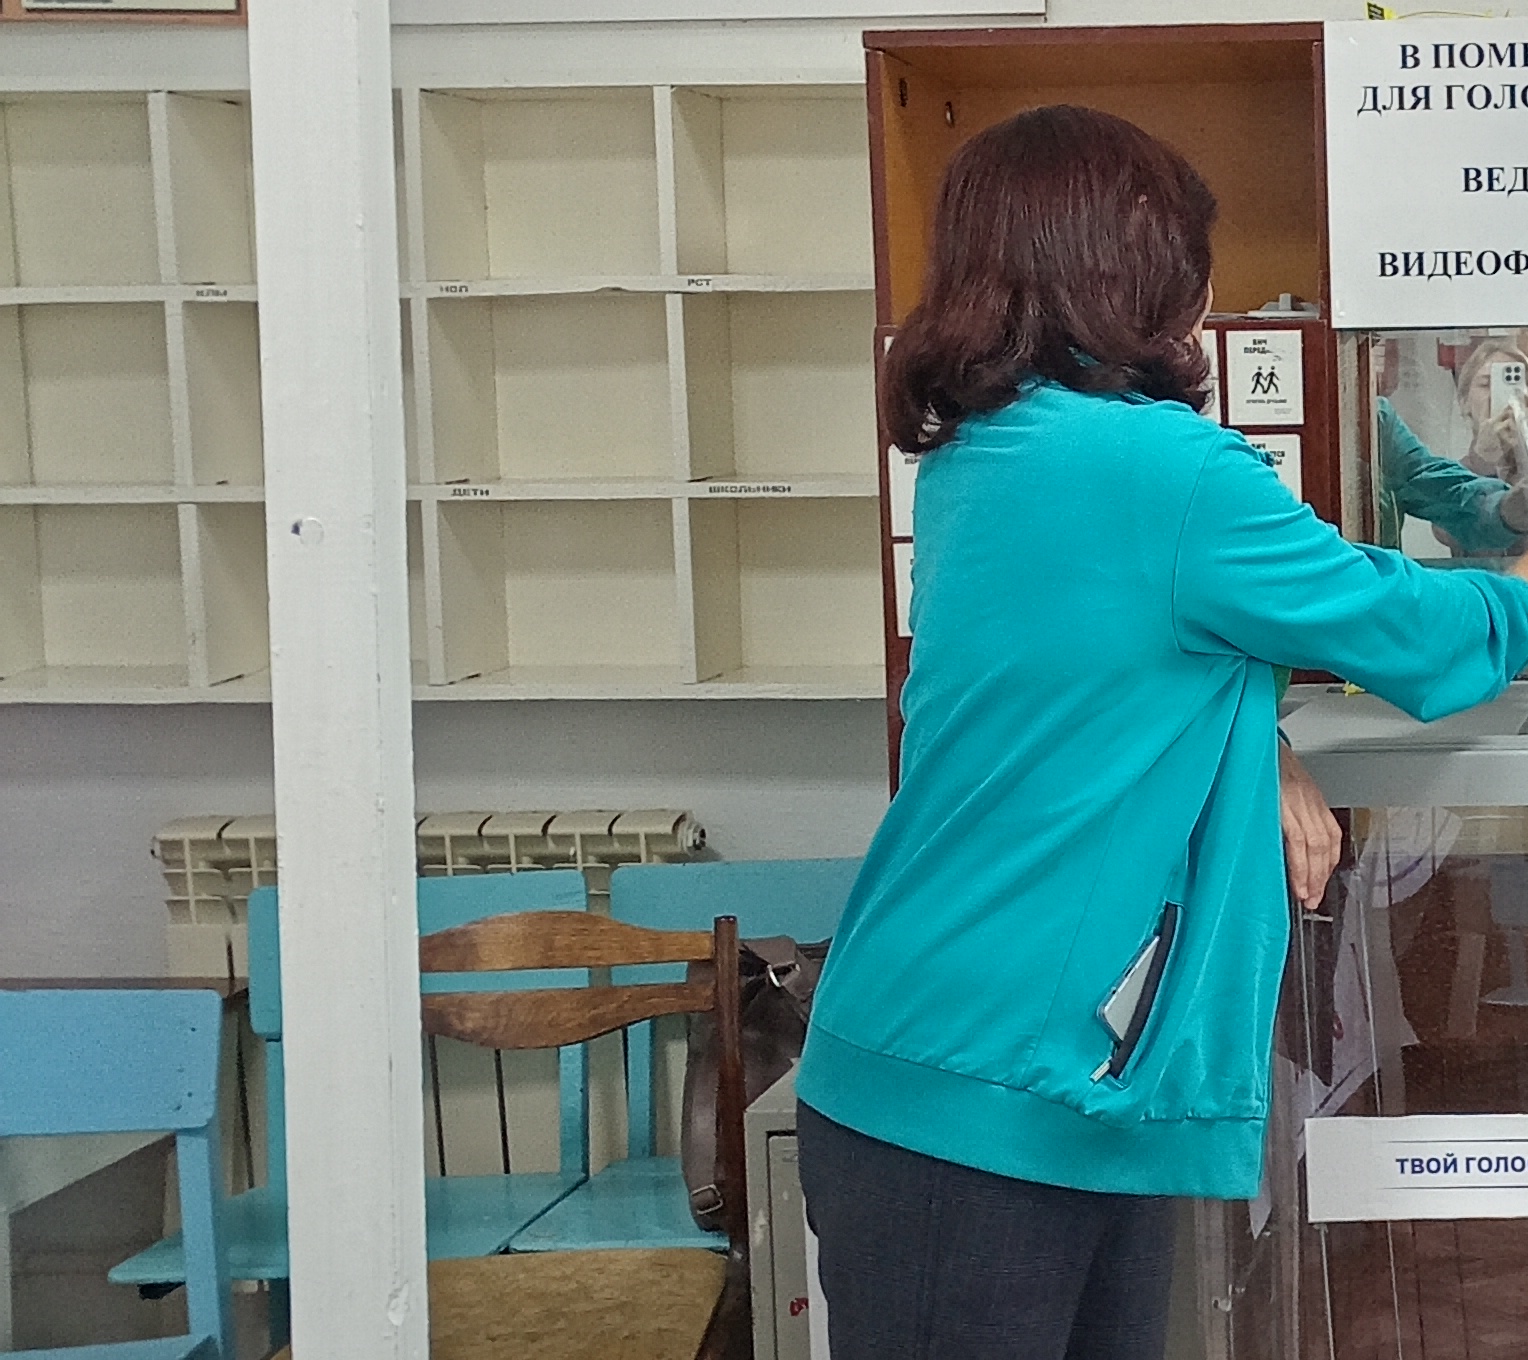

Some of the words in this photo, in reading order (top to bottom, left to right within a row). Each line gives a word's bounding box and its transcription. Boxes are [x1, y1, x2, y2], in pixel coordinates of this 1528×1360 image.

[1400, 43, 1421, 70] В
[1357, 85, 1433, 118] ДЛЯ
[451, 488, 490, 497] ДЕТИ
[1396, 1153, 1458, 1175] ТВОЙ
